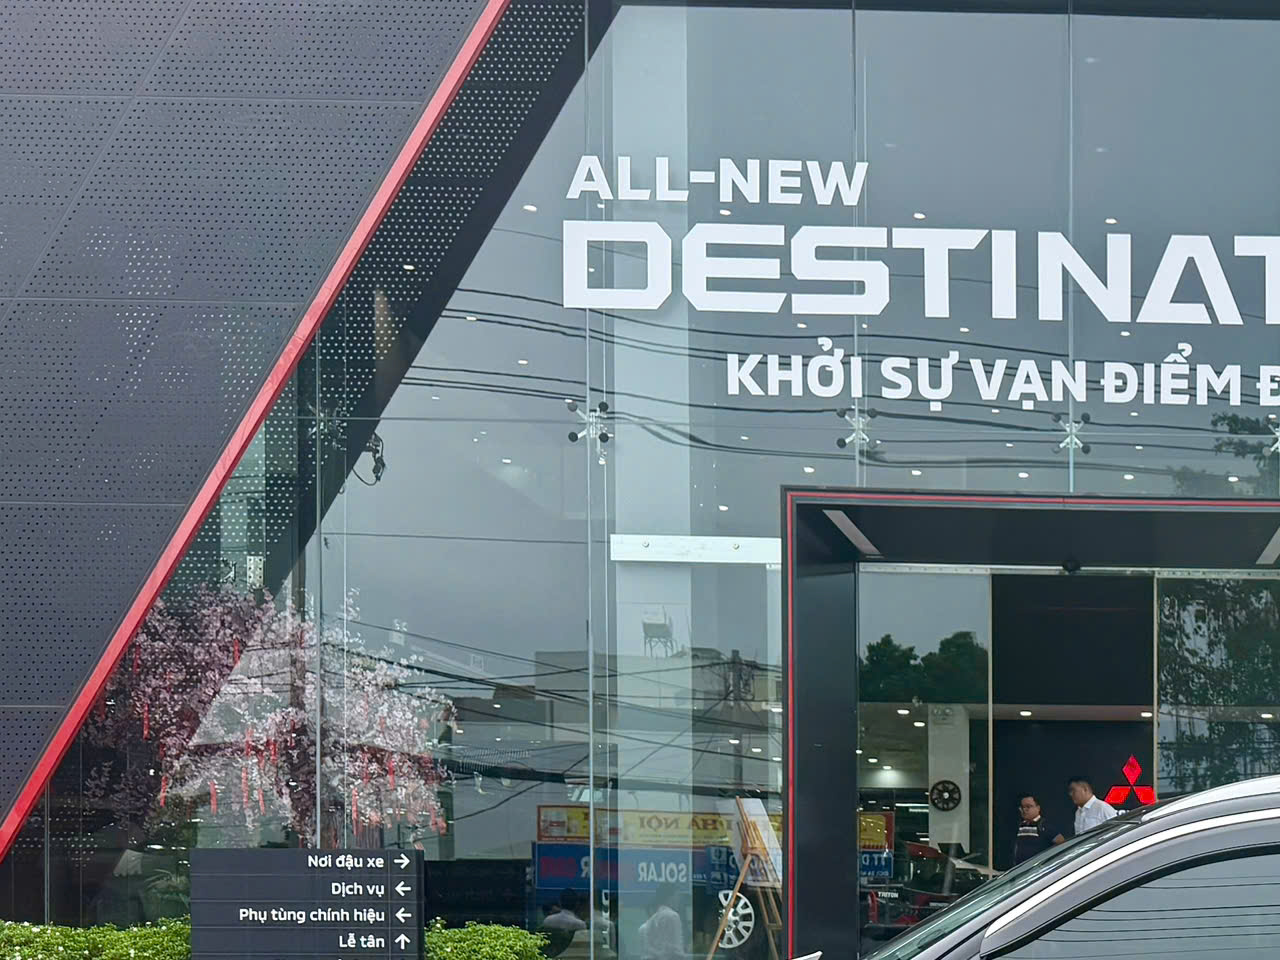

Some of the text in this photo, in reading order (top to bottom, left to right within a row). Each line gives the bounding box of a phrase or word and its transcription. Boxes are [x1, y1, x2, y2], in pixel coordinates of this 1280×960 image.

[565, 155, 869, 206] ALL-NEW
[727, 337, 863, 398] KHỞI
[880, 350, 959, 411] SỰ
[969, 358, 1087, 411] VẠN
[1100, 342, 1241, 406] ĐIỂM
[307, 854, 384, 870] Nơi đậu xe
[331, 882, 385, 897] Dịch vụ
[239, 907, 385, 924] Phụ tùng chính hiệu
[338, 933, 385, 948] Lễ tân
